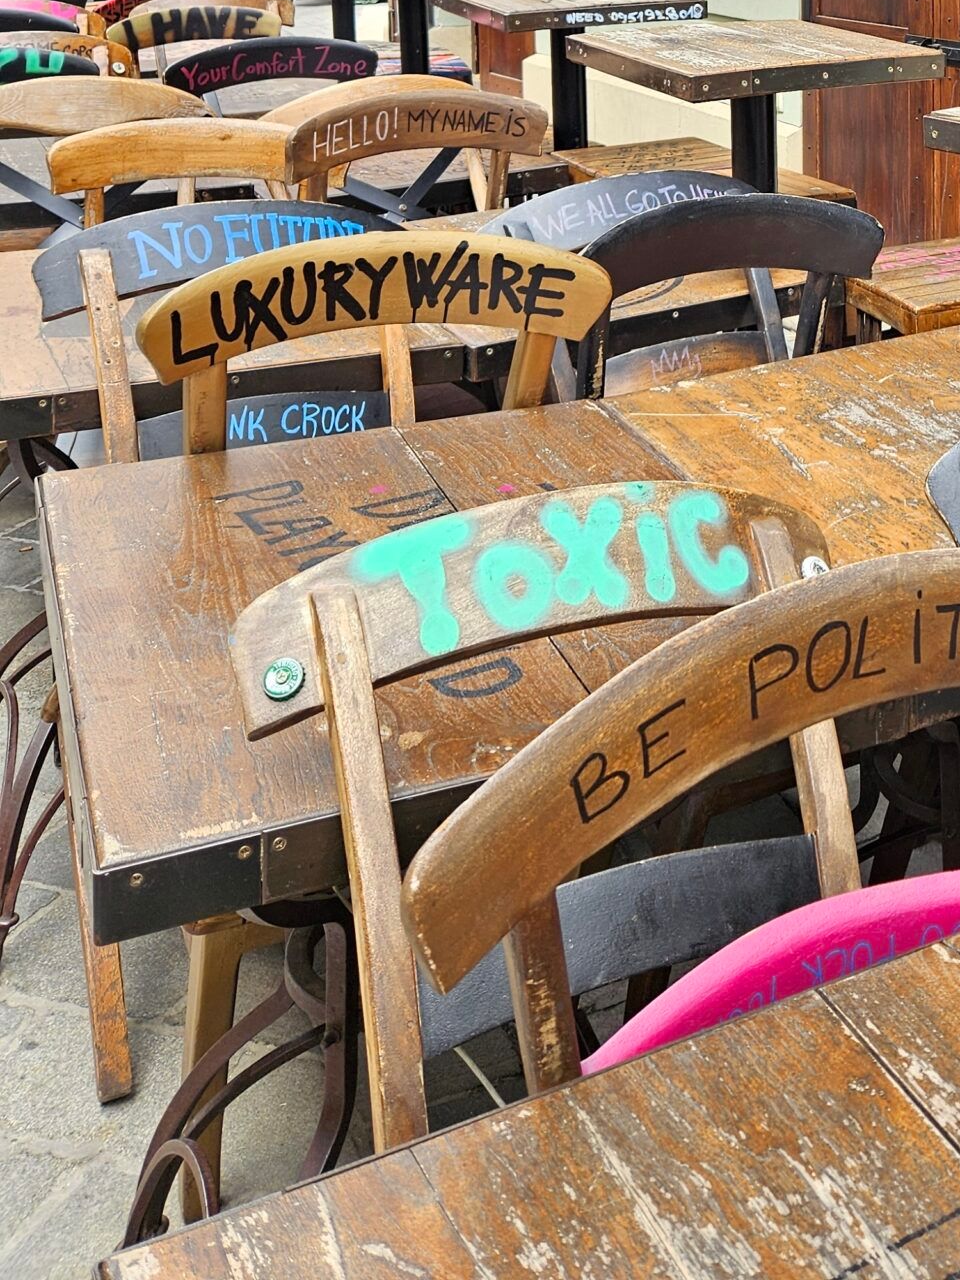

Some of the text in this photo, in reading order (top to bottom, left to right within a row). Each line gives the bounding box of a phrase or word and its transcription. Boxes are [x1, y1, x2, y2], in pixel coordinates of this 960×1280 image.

[151, 6, 270, 46] HAVE
[181, 46, 367, 90] Your Comfort Zone
[313, 106, 399, 162] HELLO!
[407, 108, 441, 133] MY
[440, 109, 500, 137] NAME
[531, 202, 586, 241] WE
[586, 192, 629, 227] ALL
[624, 188, 661, 214] GO
[127, 221, 213, 280] NO
[229, 400, 366, 442] NK CROCK
[569, 698, 687, 826] BE
